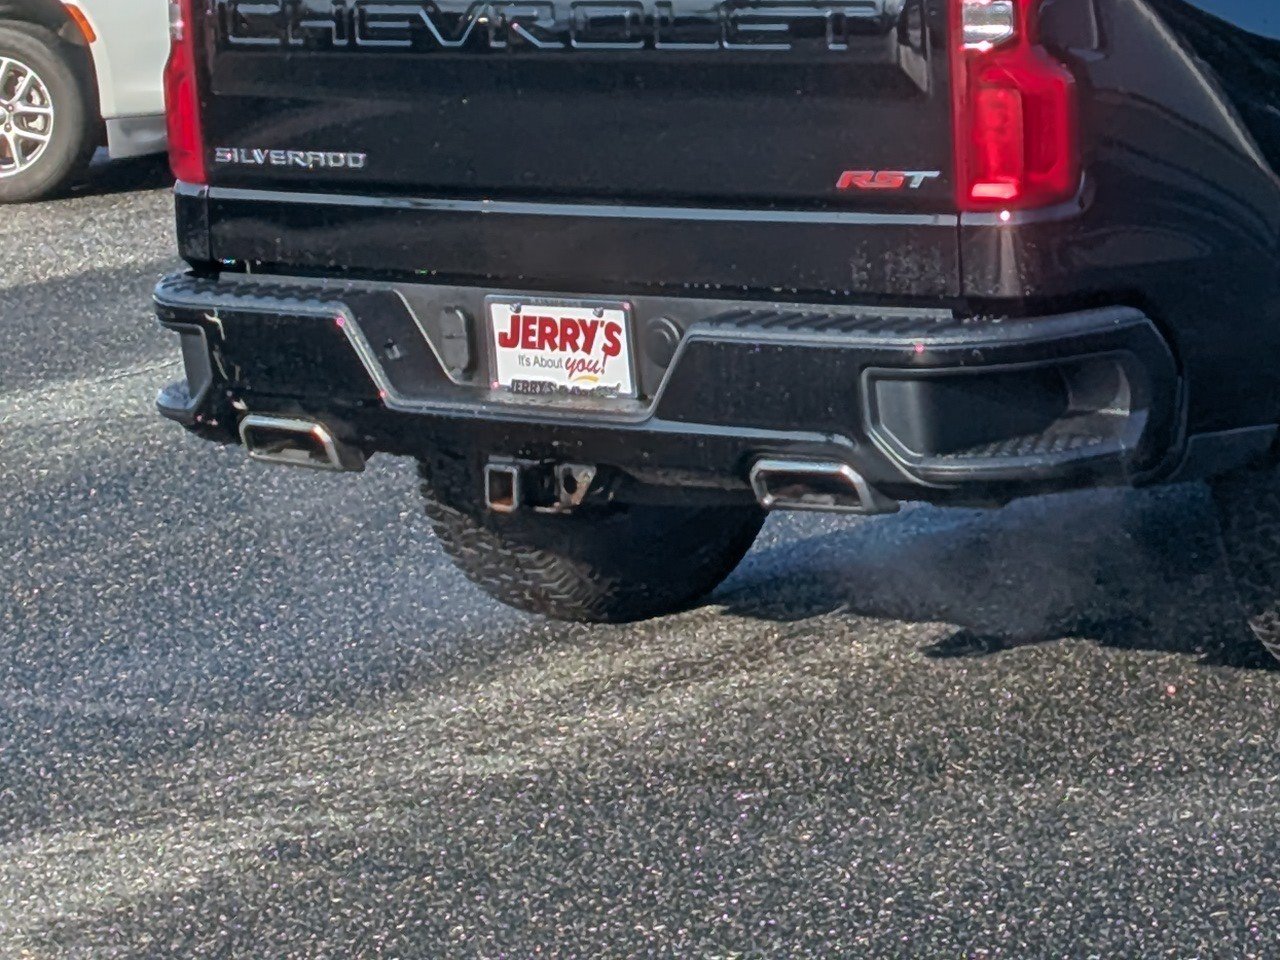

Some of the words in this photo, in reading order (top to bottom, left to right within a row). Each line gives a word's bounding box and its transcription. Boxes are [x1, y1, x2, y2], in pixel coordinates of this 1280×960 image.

[214, 147, 366, 169] SILVERADO
[836, 170, 940, 189] RST
[498, 314, 622, 357] JERRY'S
[518, 354, 531, 367] It's
[533, 355, 563, 369] About
[564, 352, 606, 379] you!
